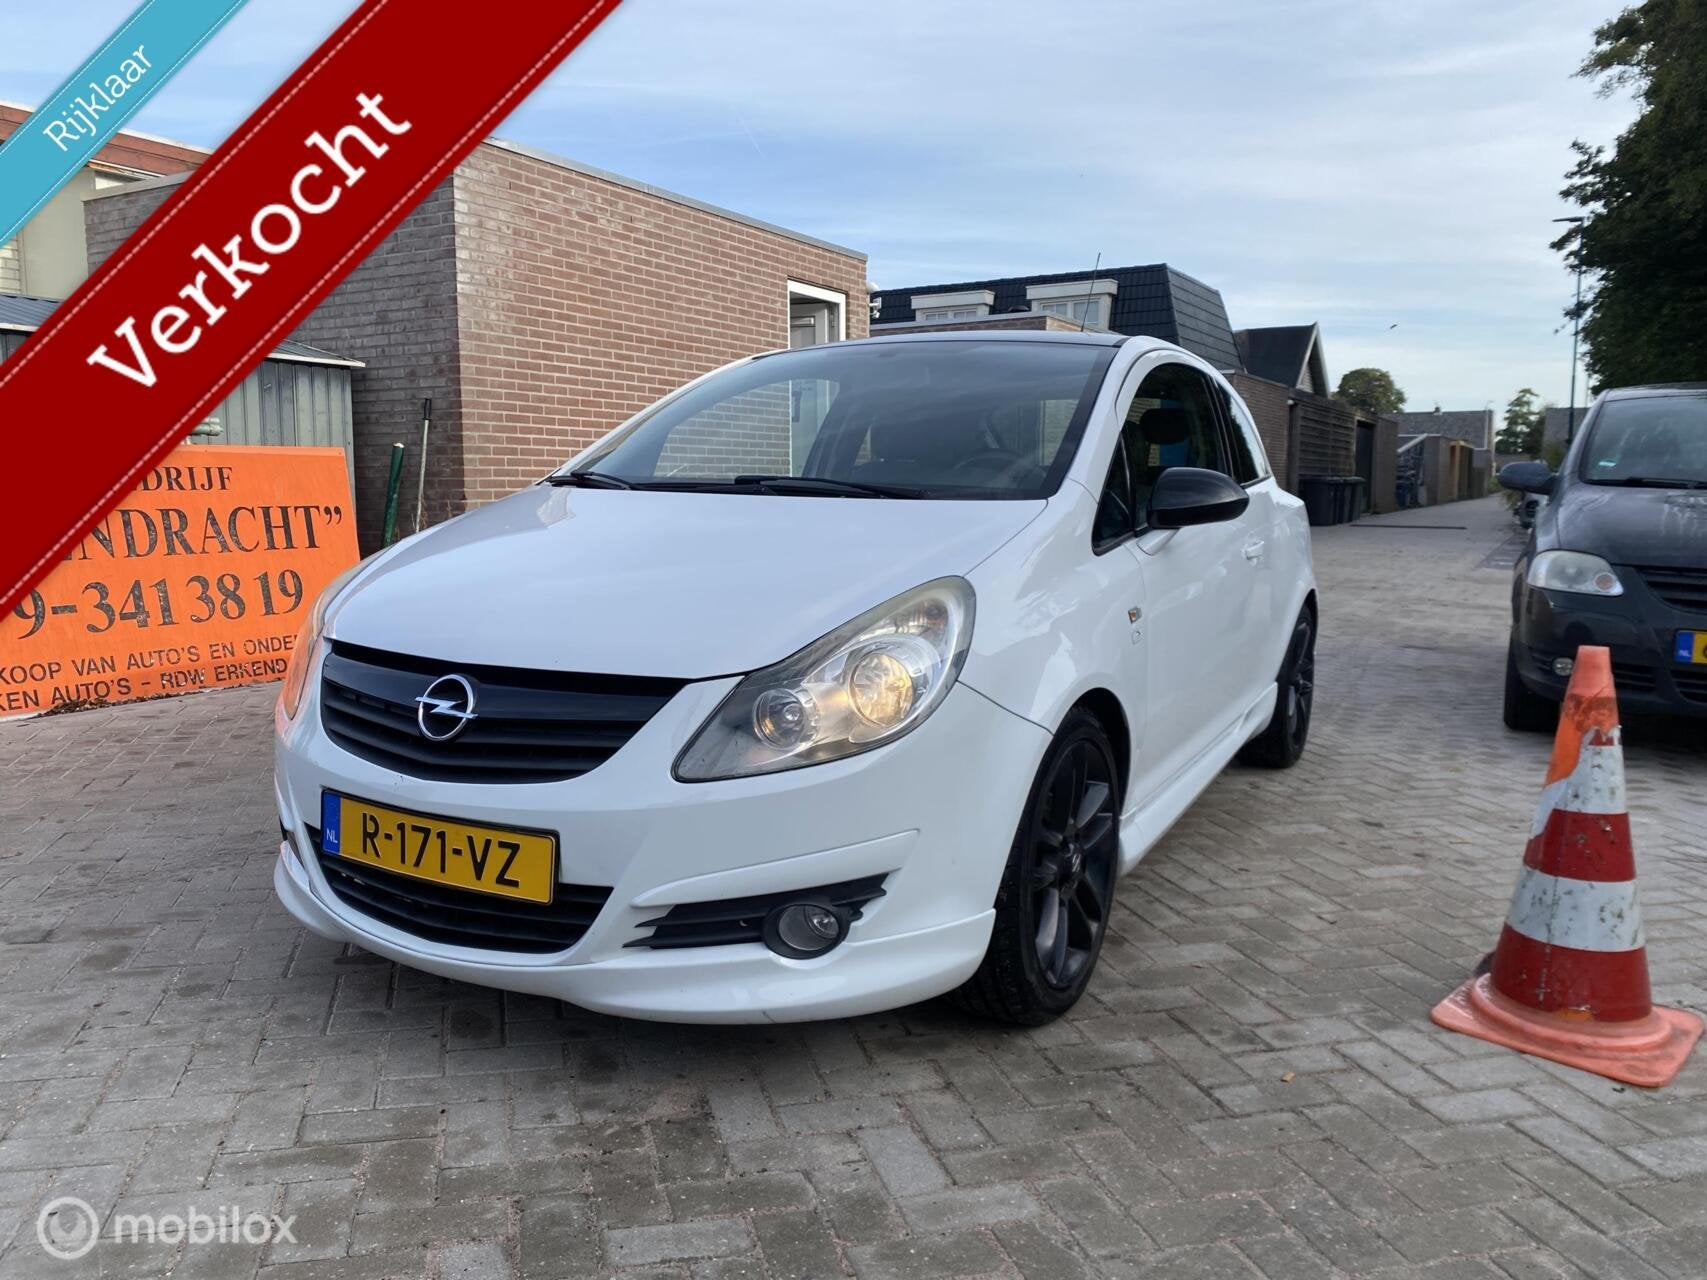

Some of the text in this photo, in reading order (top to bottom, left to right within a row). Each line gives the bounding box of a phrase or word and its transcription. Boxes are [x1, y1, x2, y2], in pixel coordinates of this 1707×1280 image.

[134, 466, 233, 491] DRIJF
[64, 505, 343, 561] NDRACHT”
[51, 677, 131, 705] AUTO'S
[160, 667, 206, 690] RDW
[214, 657, 288, 682] ERKEND
[72, 655, 116, 677] VAN
[127, 645, 201, 670] AUTO'S
[209, 641, 236, 660] EN
[326, 812, 521, 888] NL R-171-VZ
